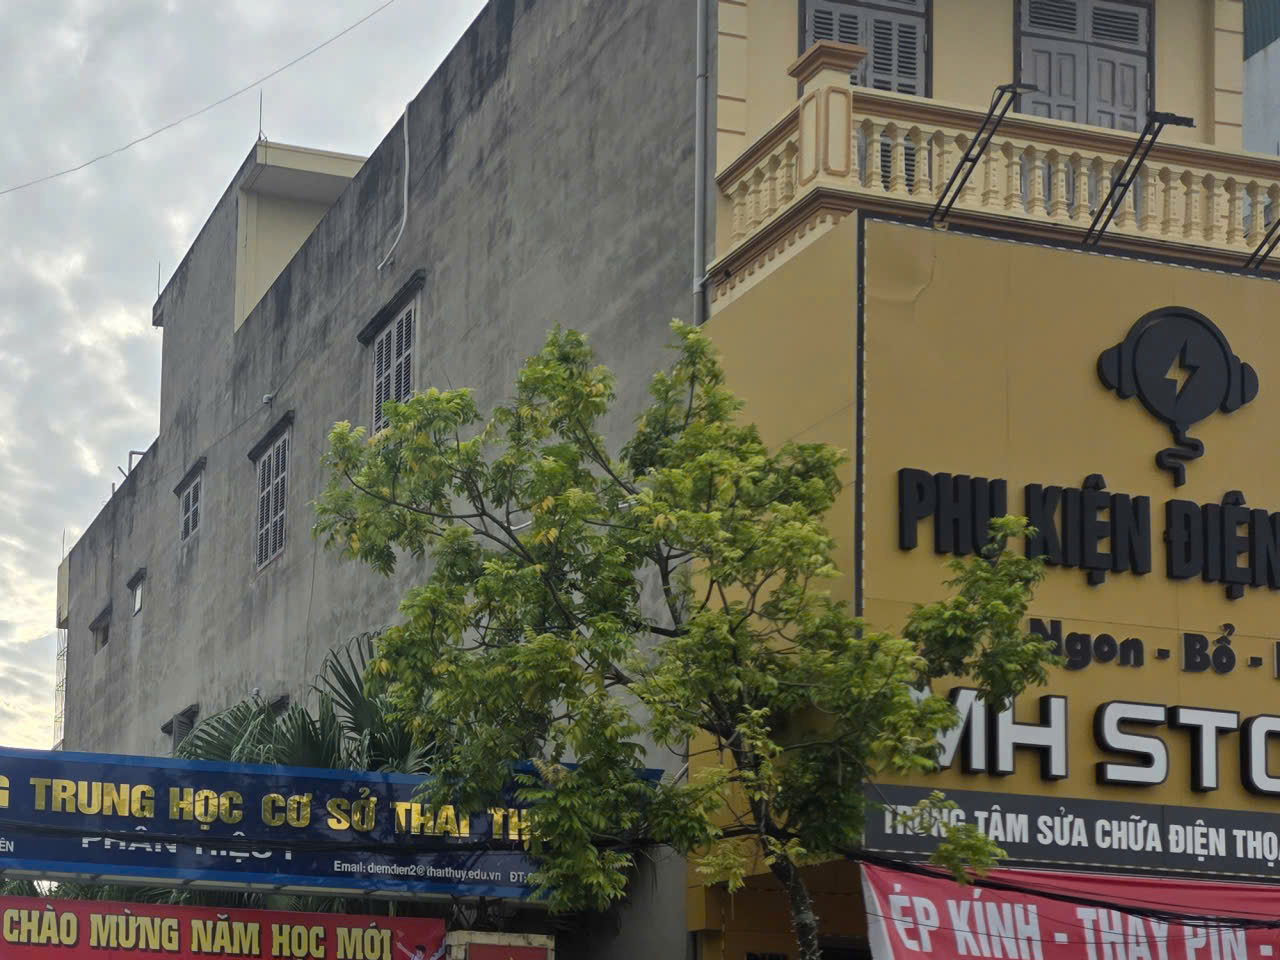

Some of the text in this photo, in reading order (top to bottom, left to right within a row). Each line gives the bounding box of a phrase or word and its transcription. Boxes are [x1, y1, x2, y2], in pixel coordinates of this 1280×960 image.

[1024, 473, 1151, 585] KIỆN
[1029, 618, 1144, 670] Ngon
[1181, 622, 1236, 674] Bổ
[29, 777, 156, 819] TRUNG
[169, 787, 244, 831] HỌC
[261, 792, 313, 828] CƠ
[326, 786, 378, 832] SỞ
[974, 805, 1030, 844] TÂM
[1037, 807, 1088, 847] SỬA
[1095, 813, 1163, 853] CHỮA
[1169, 820, 1226, 861] ĐIỆN
[1233, 830, 1280, 868] THỌ
[334, 860, 366, 873] Email:
[510, 871, 534, 883] ĐT:
[2, 904, 78, 946] CHÀO
[89, 908, 179, 952] MỪNG
[191, 913, 261, 956] NĂM
[337, 921, 392, 960] MỚI
[888, 883, 940, 952] ÉP
[946, 888, 1044, 960] KÍNH
